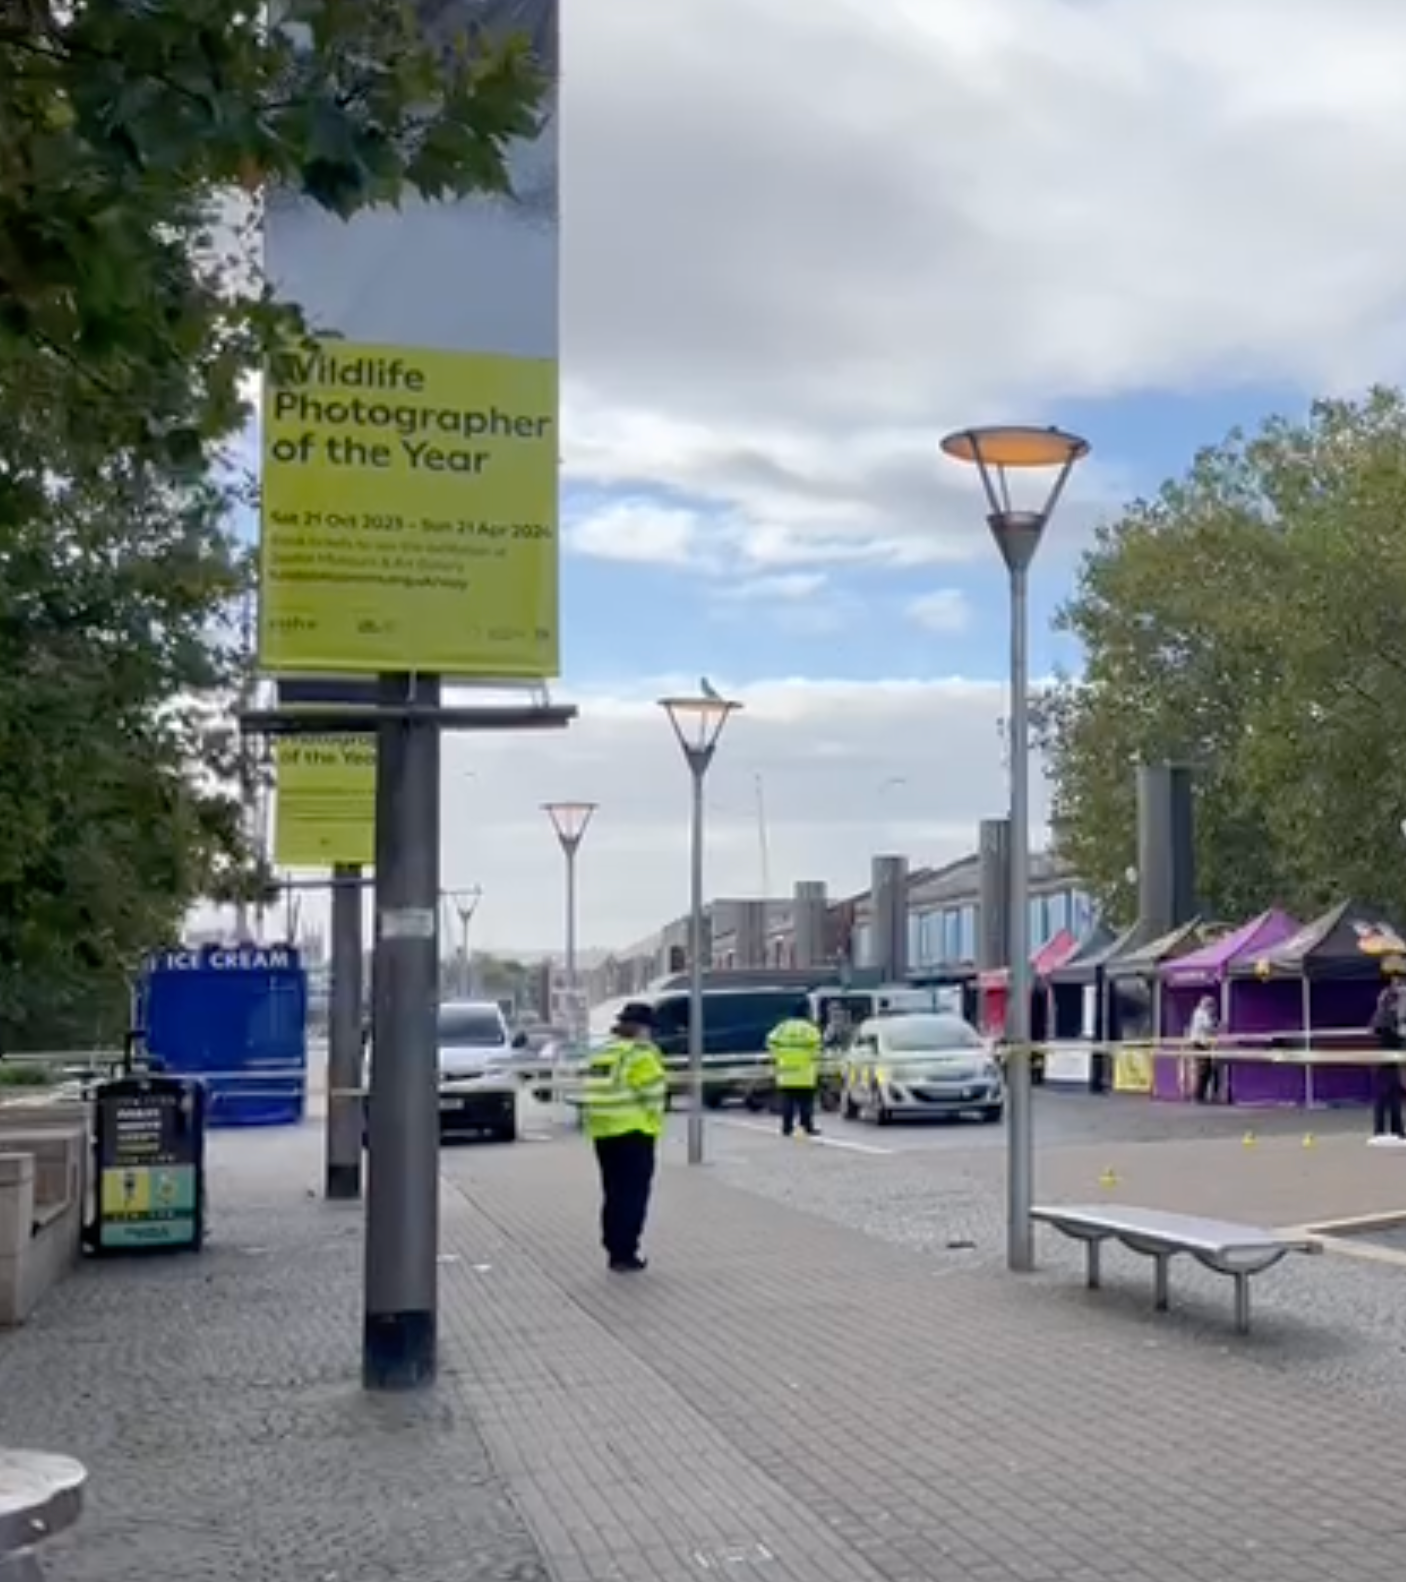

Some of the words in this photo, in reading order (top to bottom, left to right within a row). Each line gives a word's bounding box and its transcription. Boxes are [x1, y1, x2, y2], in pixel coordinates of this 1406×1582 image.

[274, 391, 552, 439] Photographer
[273, 431, 316, 464] of
[326, 436, 390, 467] the
[402, 440, 490, 474] Year
[270, 511, 298, 526] Sat
[303, 511, 322, 527] 21
[325, 513, 356, 529] Oct
[361, 513, 403, 531] 2023
[421, 518, 452, 533] Sun
[457, 520, 474, 535] 21
[477, 520, 506, 538] Apr
[341, 749, 376, 766] Yea
[167, 951, 198, 971] ICE
[208, 950, 289, 970] CREAM
